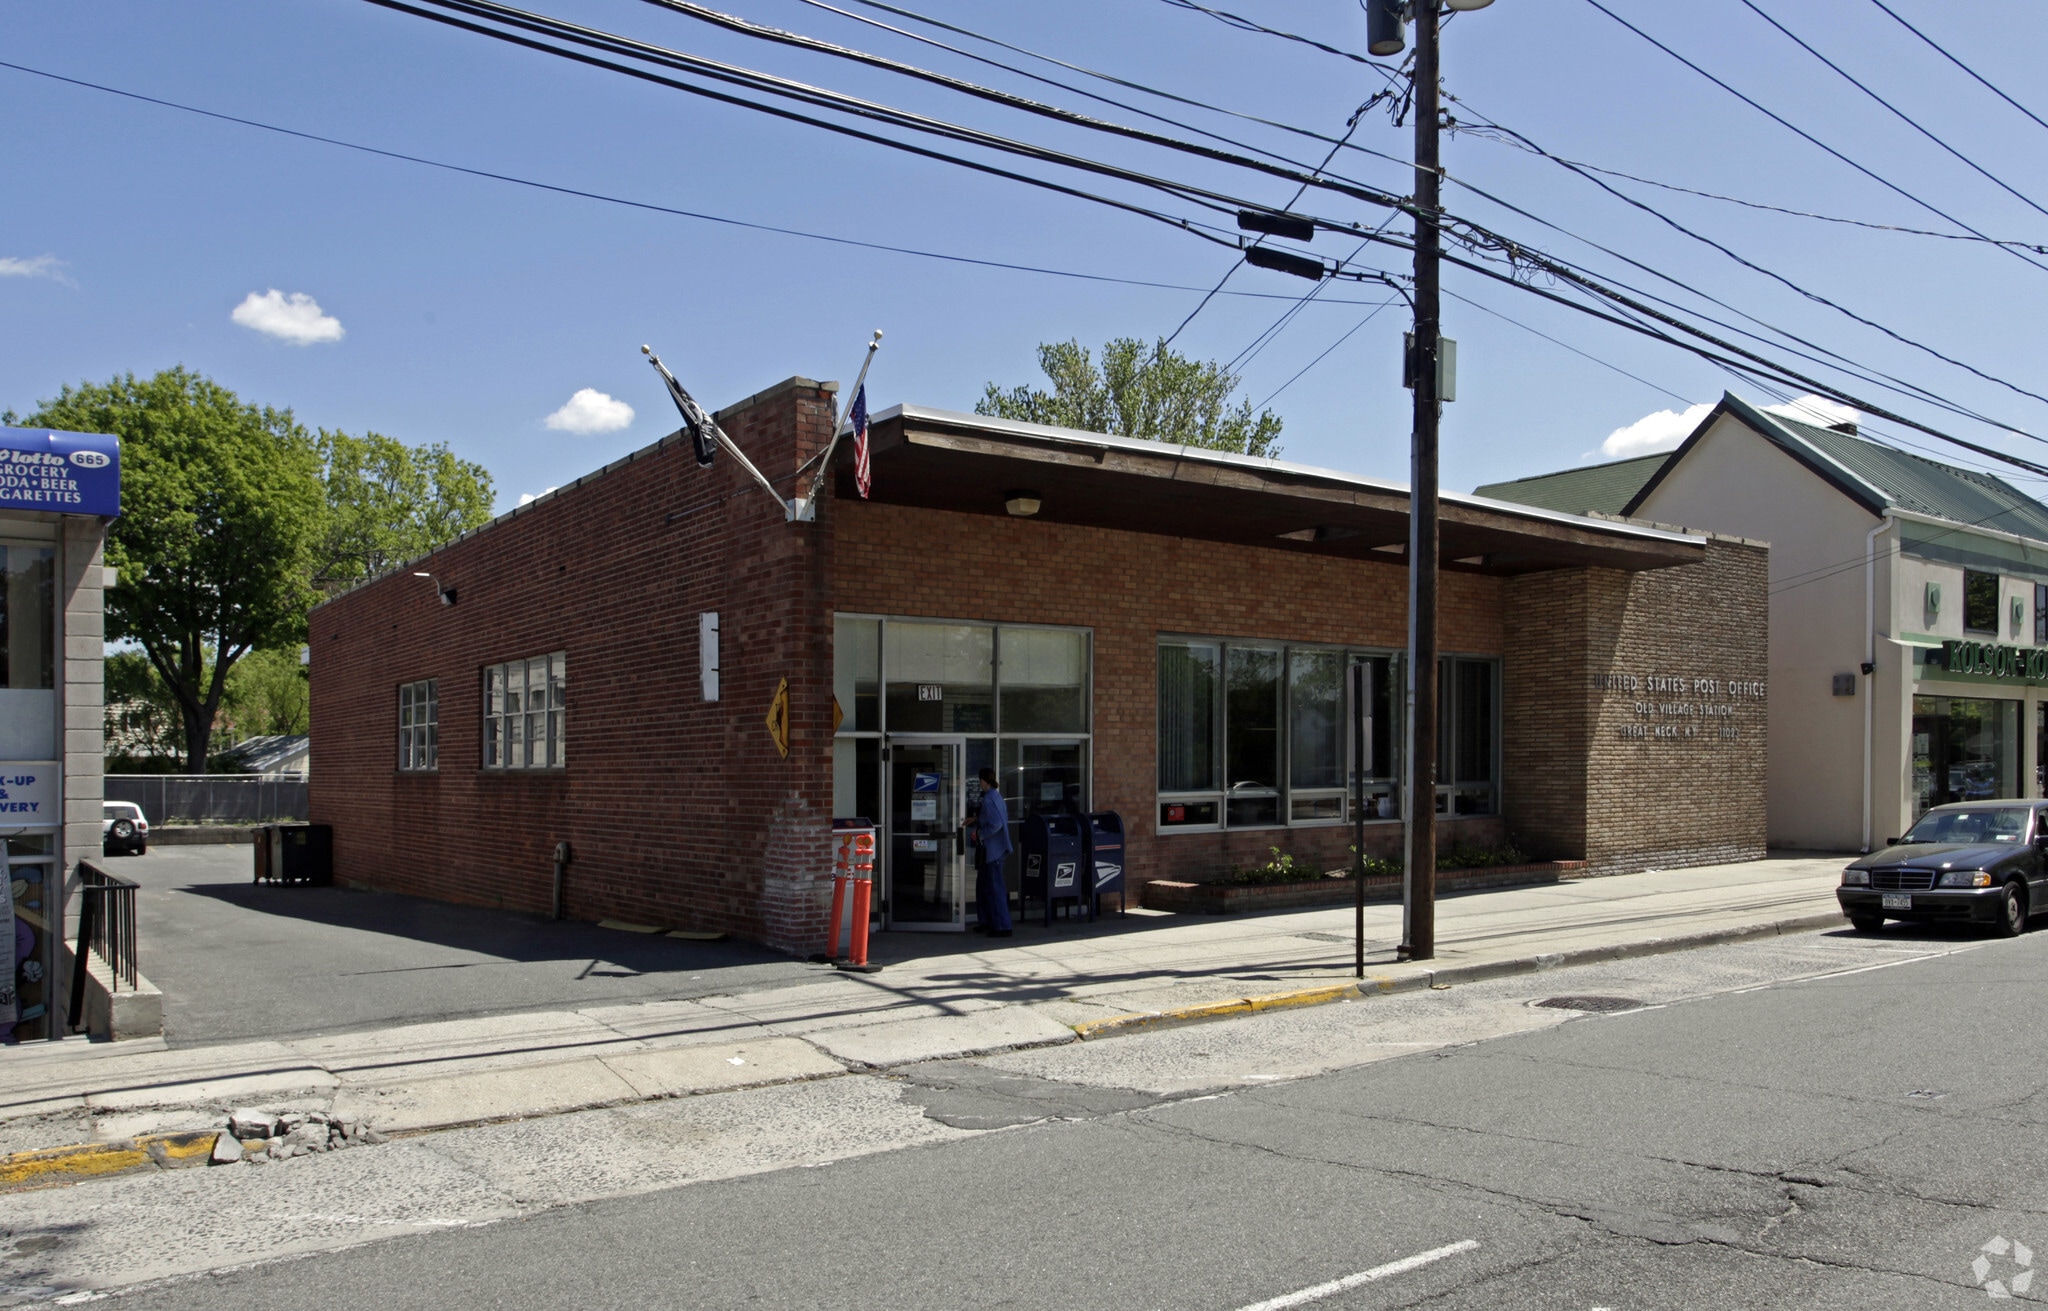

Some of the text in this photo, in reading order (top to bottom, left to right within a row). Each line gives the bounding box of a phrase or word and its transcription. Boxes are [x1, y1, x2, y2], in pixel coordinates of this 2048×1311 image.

[11, 450, 65, 466] lotto
[76, 453, 104, 465] 665
[41, 478, 78, 491] BEER
[1594, 674, 1765, 696] UNITED STATES POST OFFICE
[920, 686, 941, 700] EXIT
[1635, 702, 1733, 716] OLD VILLAGE STATION
[1620, 725, 1648, 737] GREAT
